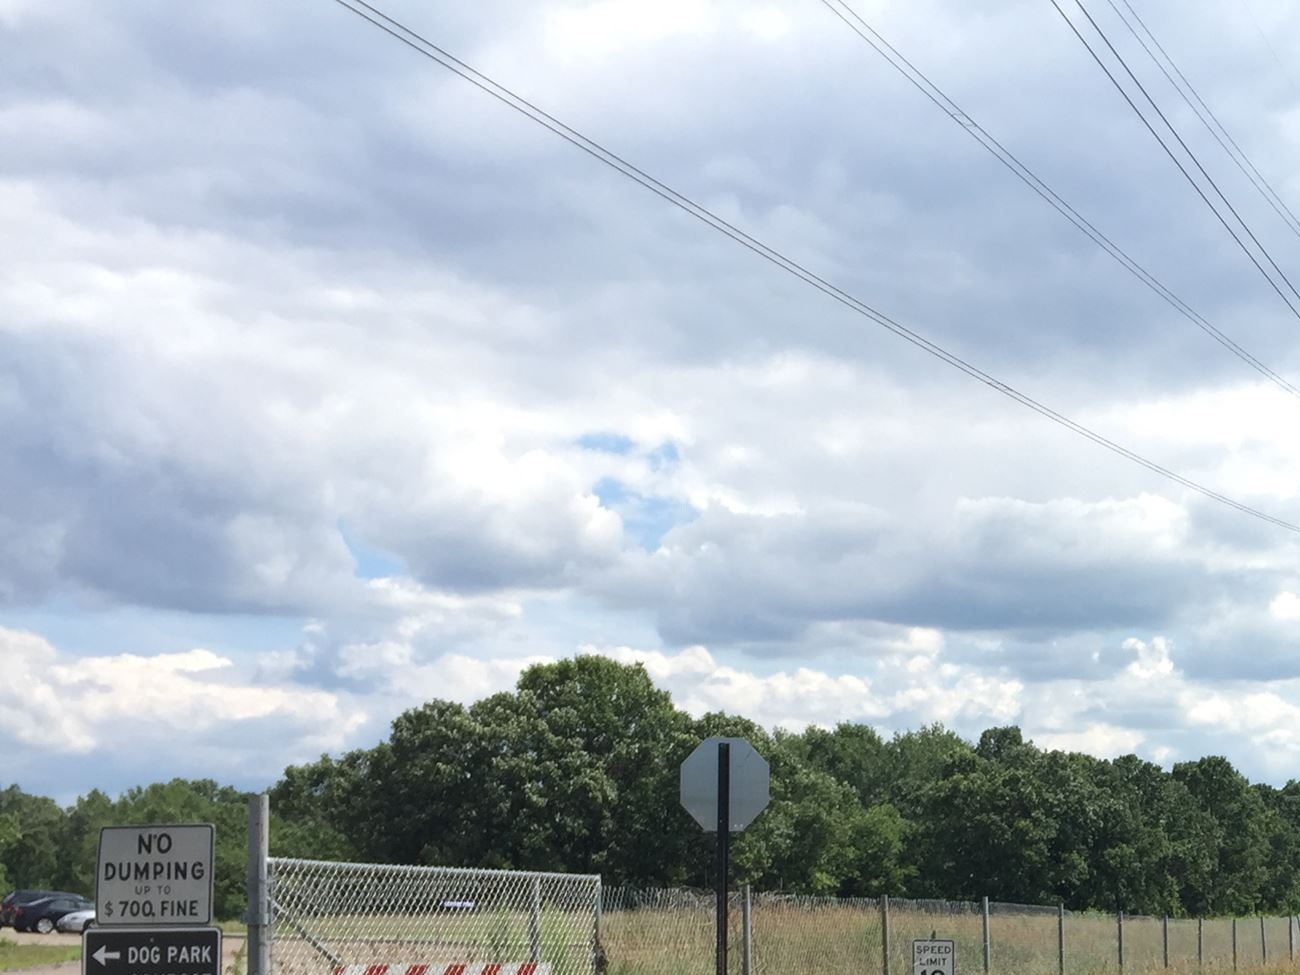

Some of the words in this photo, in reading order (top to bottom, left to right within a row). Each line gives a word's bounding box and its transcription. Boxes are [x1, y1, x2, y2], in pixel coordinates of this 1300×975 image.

[137, 833, 172, 854] NO
[104, 862, 205, 881] DUMPING
[135, 885, 150, 895] UP
[157, 885, 171, 895] TO
[160, 900, 198, 916] FINE
[128, 946, 160, 963] DOG
[167, 945, 211, 963] PARK
[916, 946, 951, 954] SPEED
[920, 958, 947, 966] LIMIT
